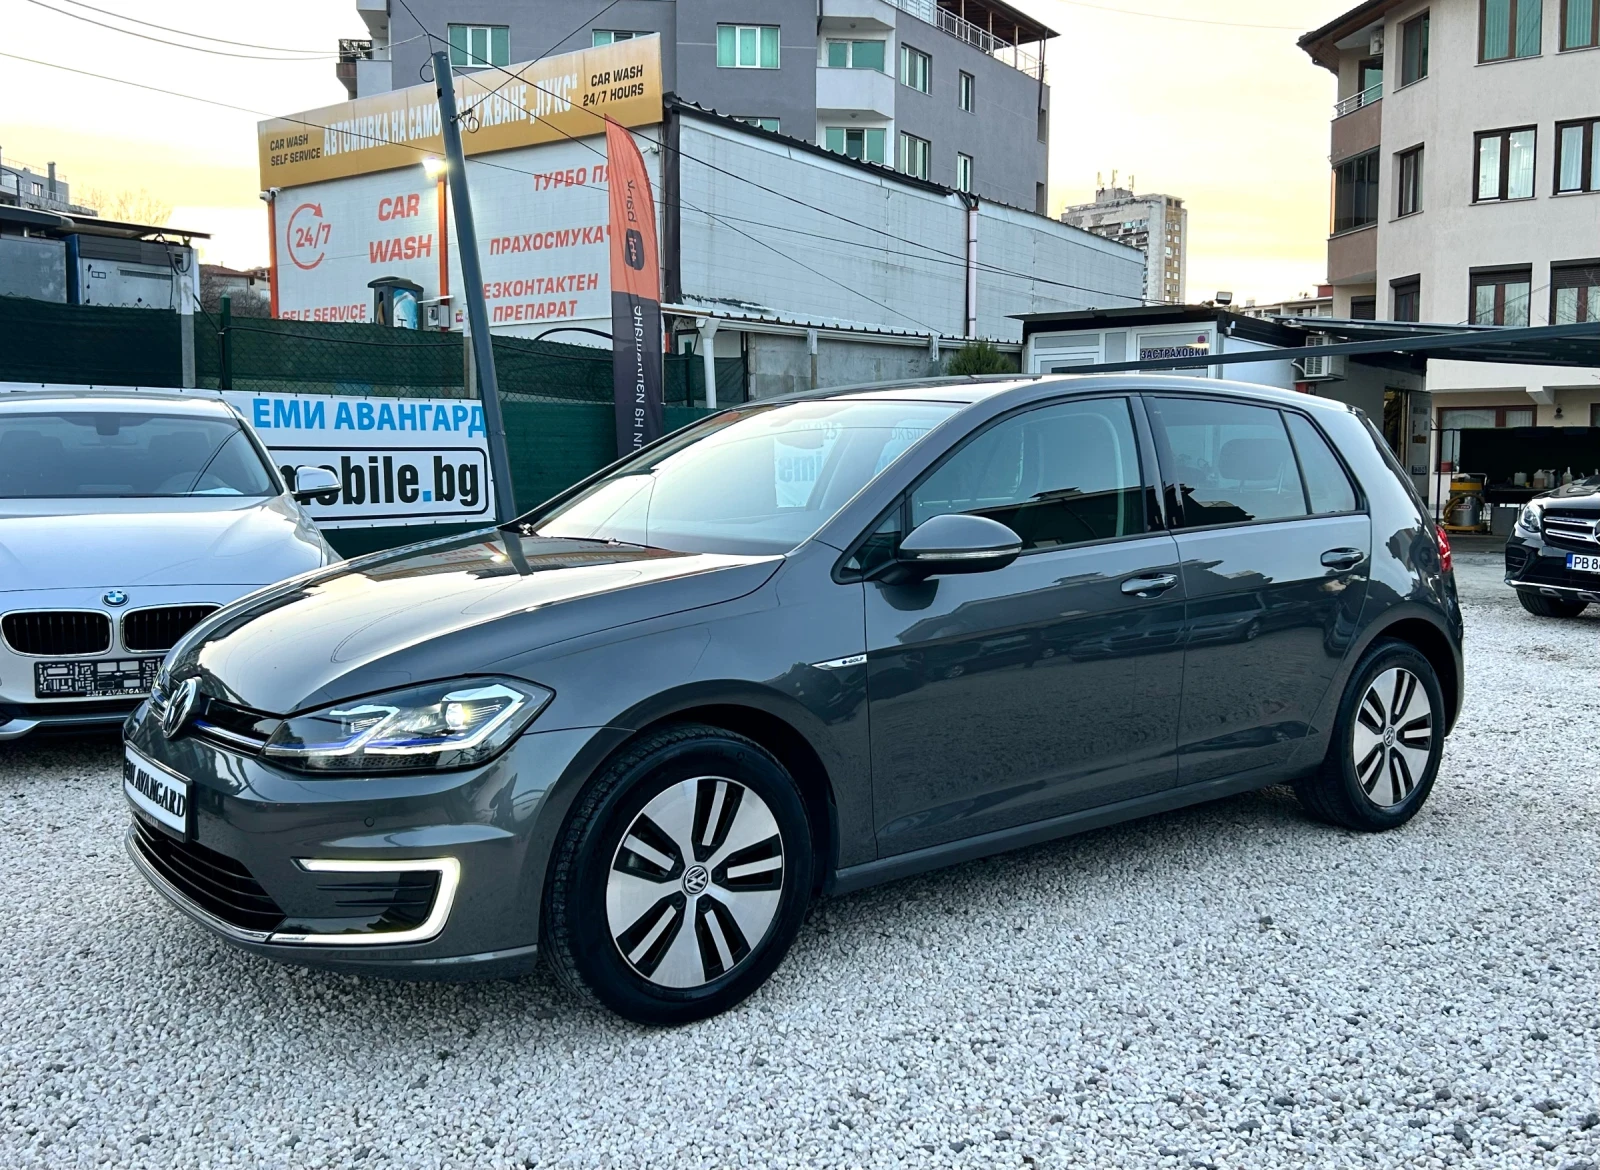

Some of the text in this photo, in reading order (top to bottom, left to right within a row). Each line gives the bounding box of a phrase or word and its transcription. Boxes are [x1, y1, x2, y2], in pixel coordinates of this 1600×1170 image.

[591, 64, 643, 87] CAR WASH
[583, 83, 644, 107] 24/7 HOURS
[323, 111, 389, 157] АВТОМИВКА
[391, 107, 407, 143] НА
[408, 84, 527, 141] САМОСЛУЖВАНЕ
[270, 134, 308, 151] CAR WASH
[271, 147, 321, 167] SELF SERVICE
[534, 167, 587, 191] ТУРБО
[378, 194, 420, 221] CAR
[295, 222, 331, 249] 24/7
[369, 234, 432, 264] WASH
[483, 273, 599, 299] ЕЗКОНТАКТЕН
[314, 303, 366, 322] SERVICE
[493, 300, 578, 322] ПРЕПАРАТ
[1141, 348, 1208, 359] ЗАСТРАХОВКИ
[252, 398, 486, 438] ЕМИ АВАНГАРД
[1573, 556, 1589, 569] PB
[1591, 558, 1600, 570] 8
[135, 768, 187, 817] AVANGARD
